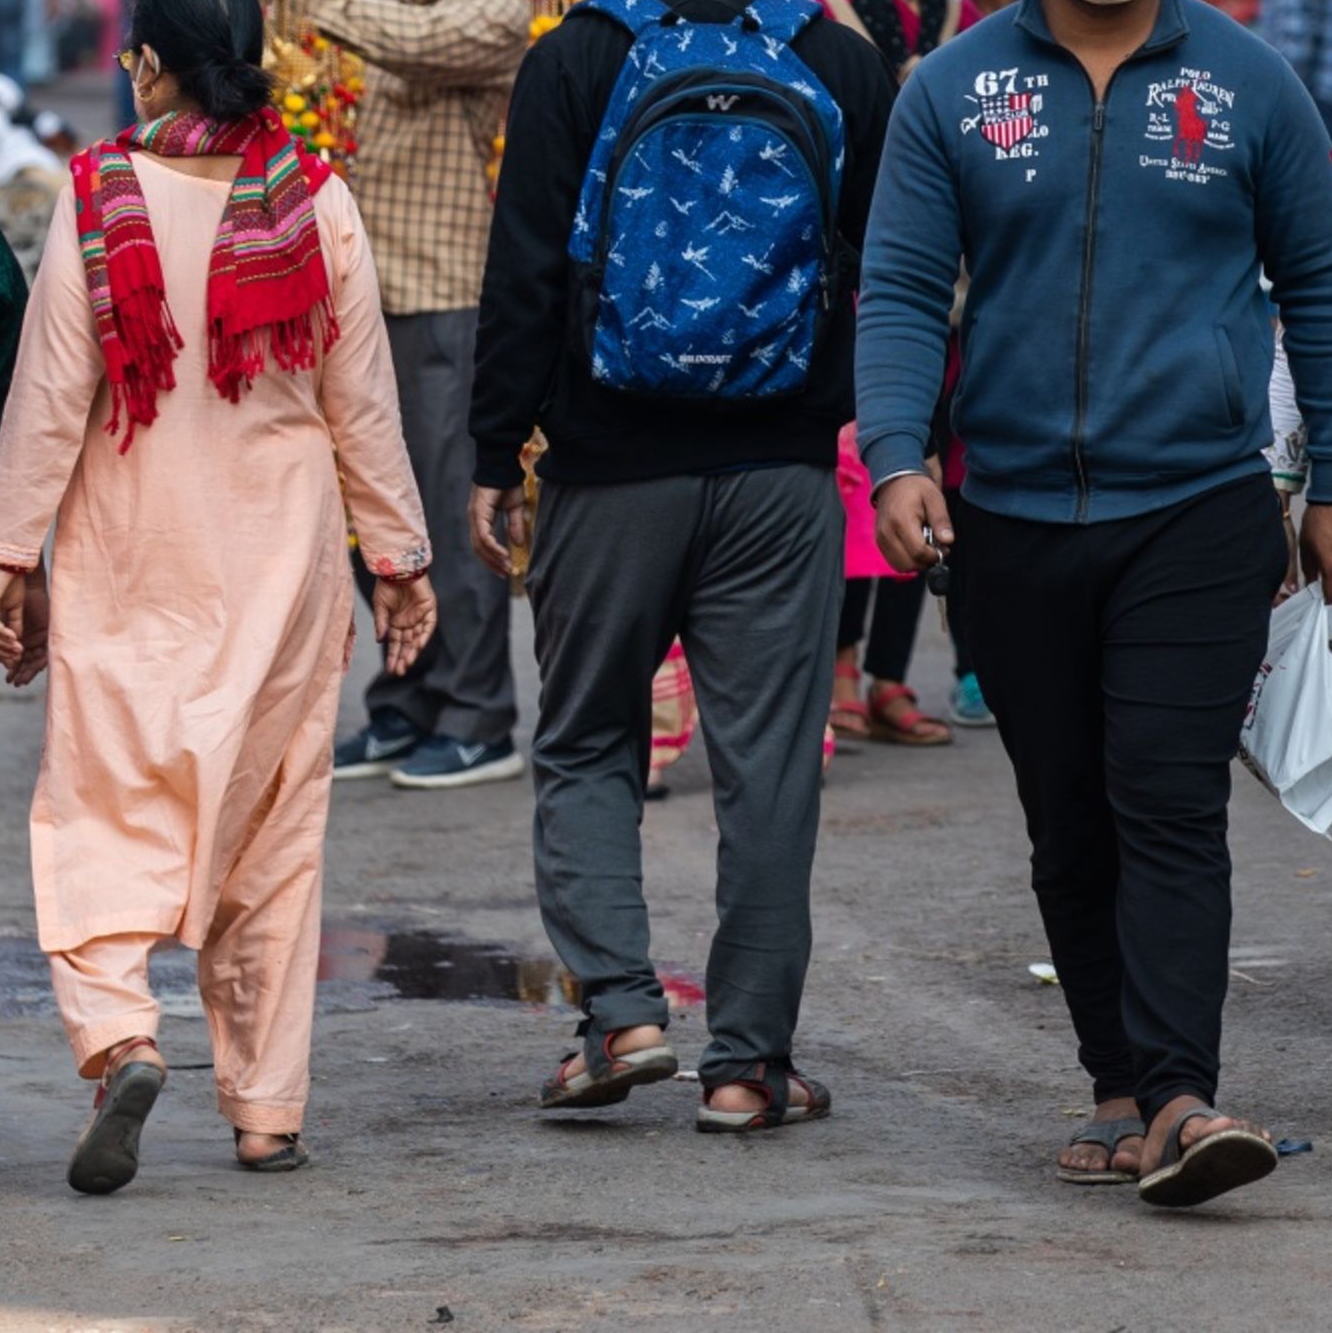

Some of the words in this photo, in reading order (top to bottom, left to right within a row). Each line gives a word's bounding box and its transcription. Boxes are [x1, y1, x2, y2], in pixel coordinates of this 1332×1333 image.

[974, 66, 1019, 96] 67
[1023, 73, 1050, 89] TH
[1179, 66, 1212, 81] POLO
[1025, 167, 1038, 183] P
